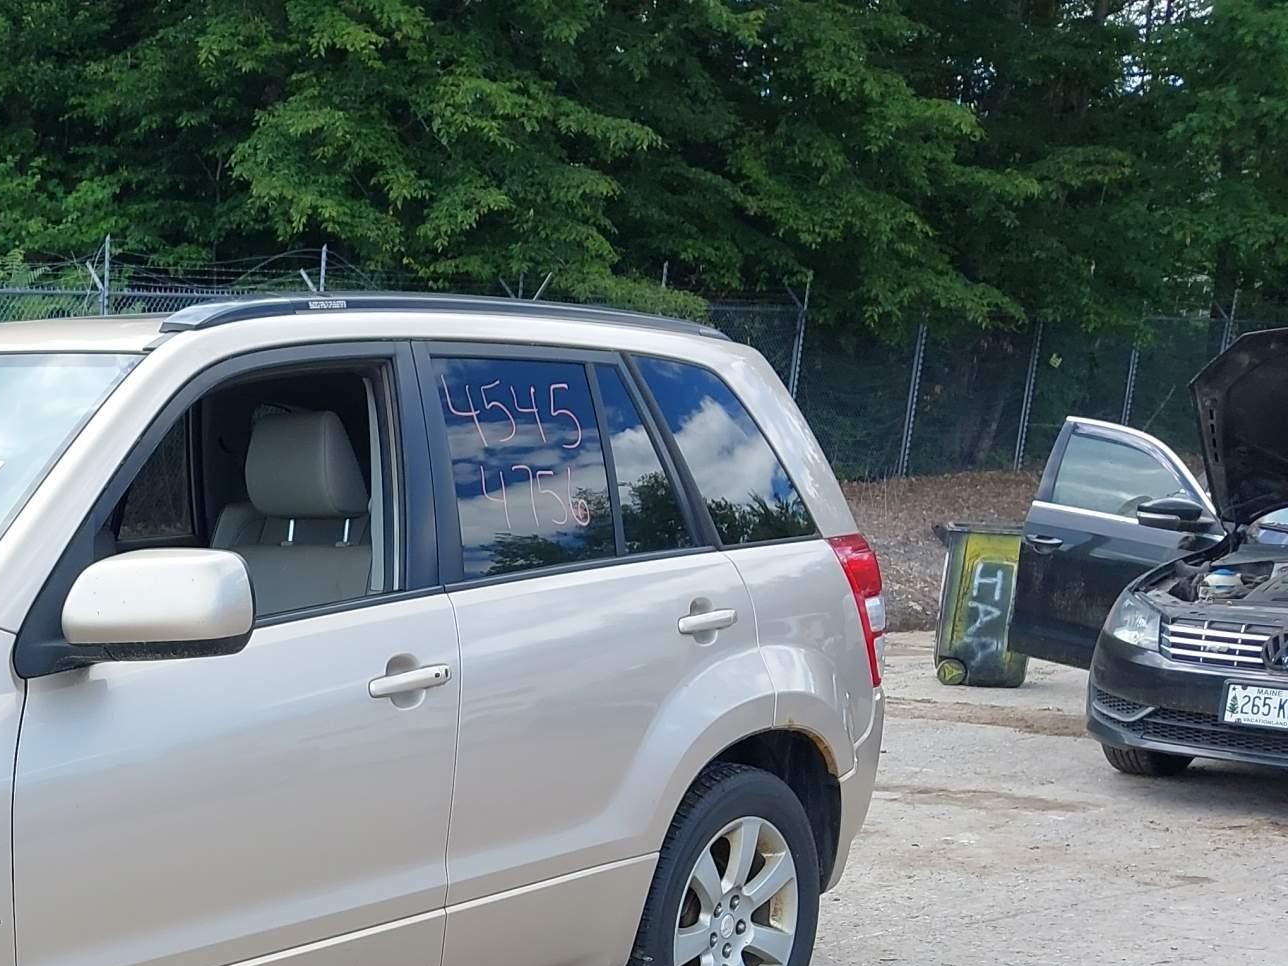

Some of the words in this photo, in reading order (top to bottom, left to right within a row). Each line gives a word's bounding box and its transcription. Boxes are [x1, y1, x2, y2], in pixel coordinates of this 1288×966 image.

[440, 374, 583, 450] 4545
[479, 464, 592, 530] 4756
[1256, 688, 1283, 697] MAINE
